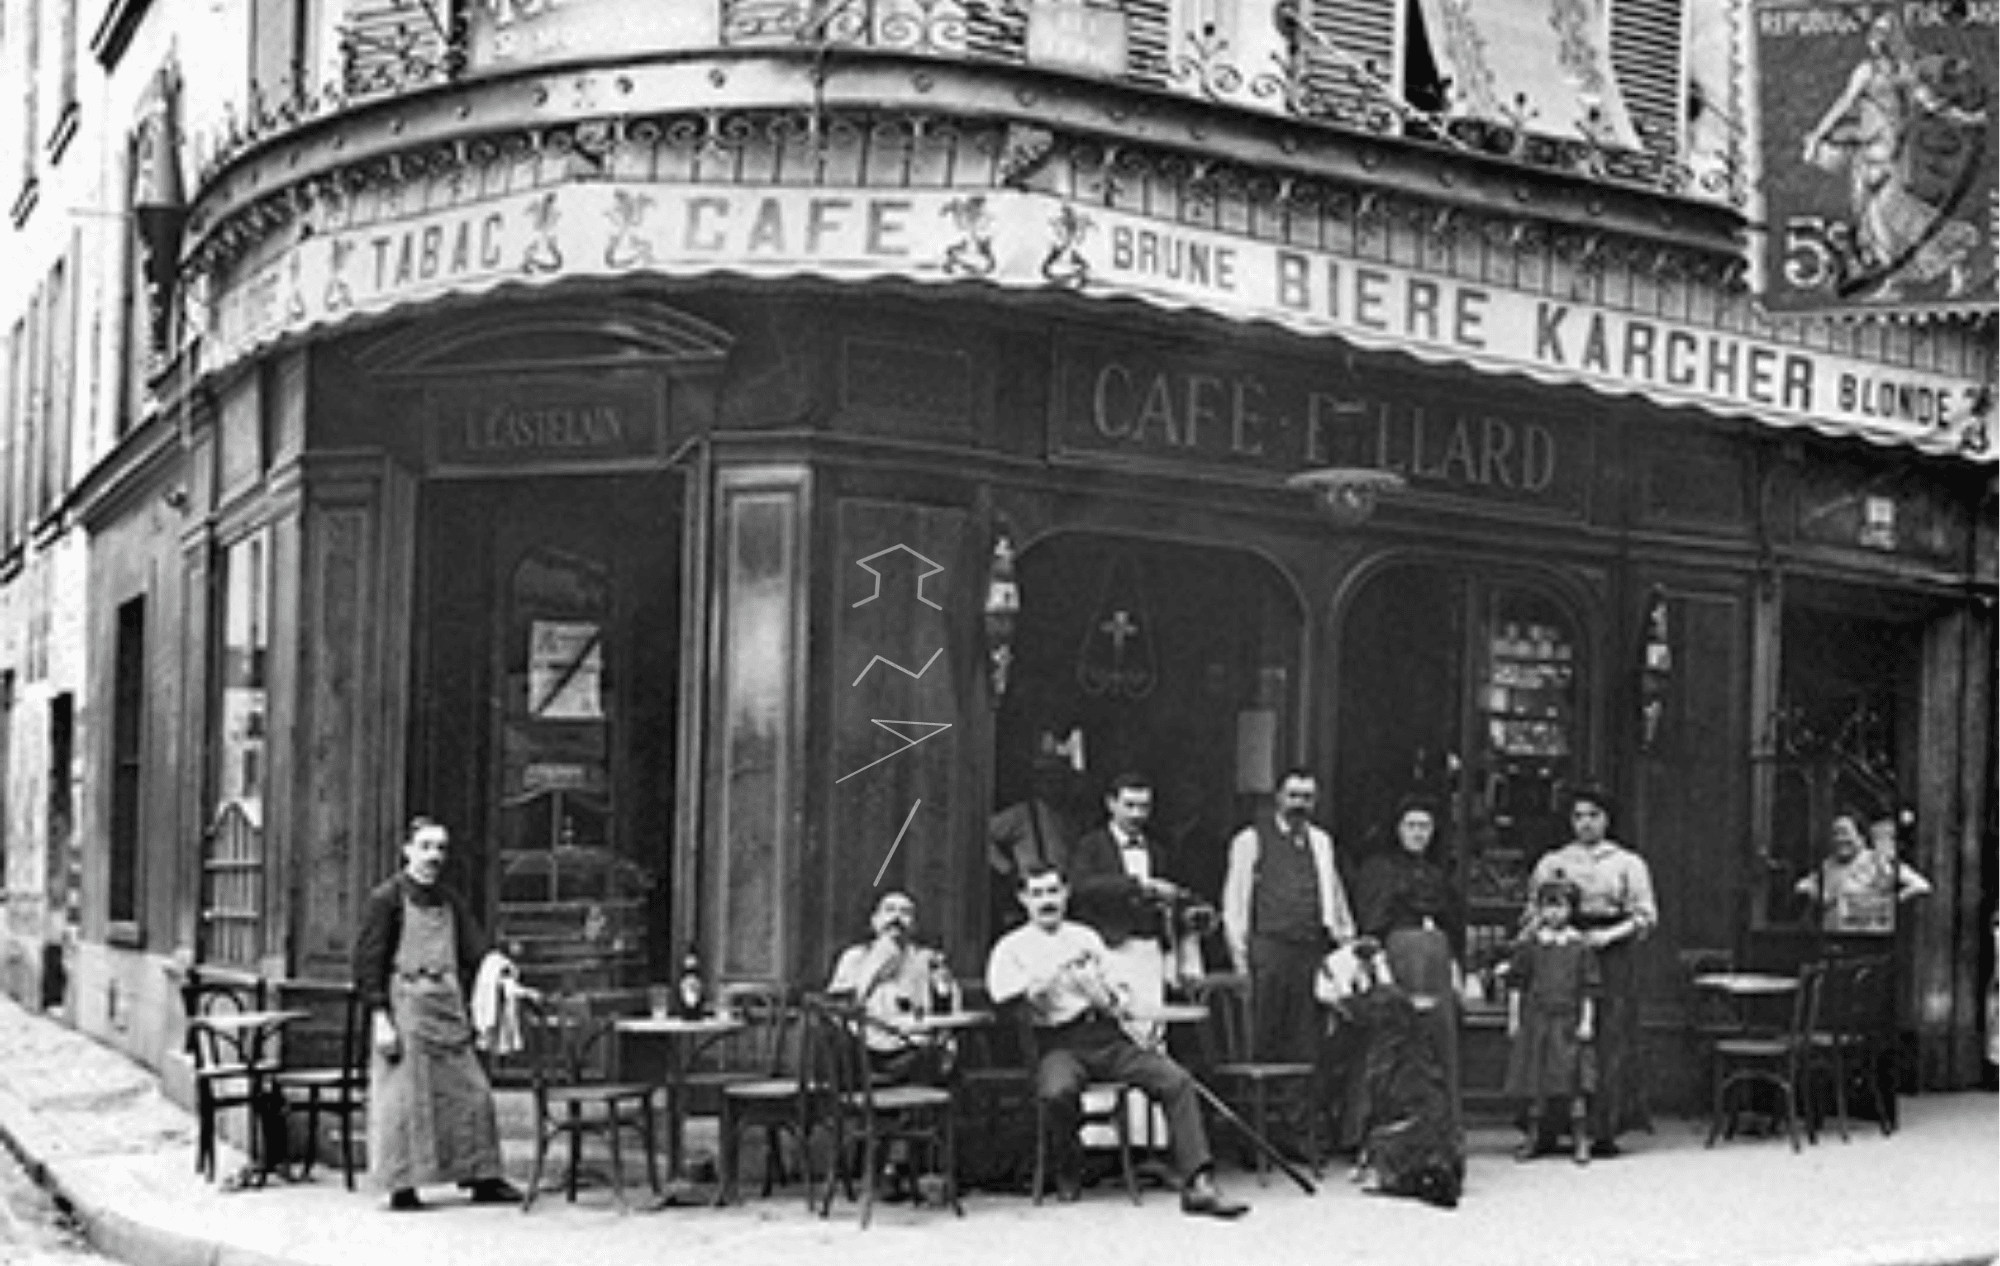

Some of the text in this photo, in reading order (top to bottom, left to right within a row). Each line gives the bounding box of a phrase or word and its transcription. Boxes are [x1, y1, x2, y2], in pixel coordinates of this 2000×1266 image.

[370, 211, 502, 289] TABAC
[683, 196, 912, 256] CAFE
[1112, 224, 1952, 430] BRUNE BIERE KARCHER BLONDE
